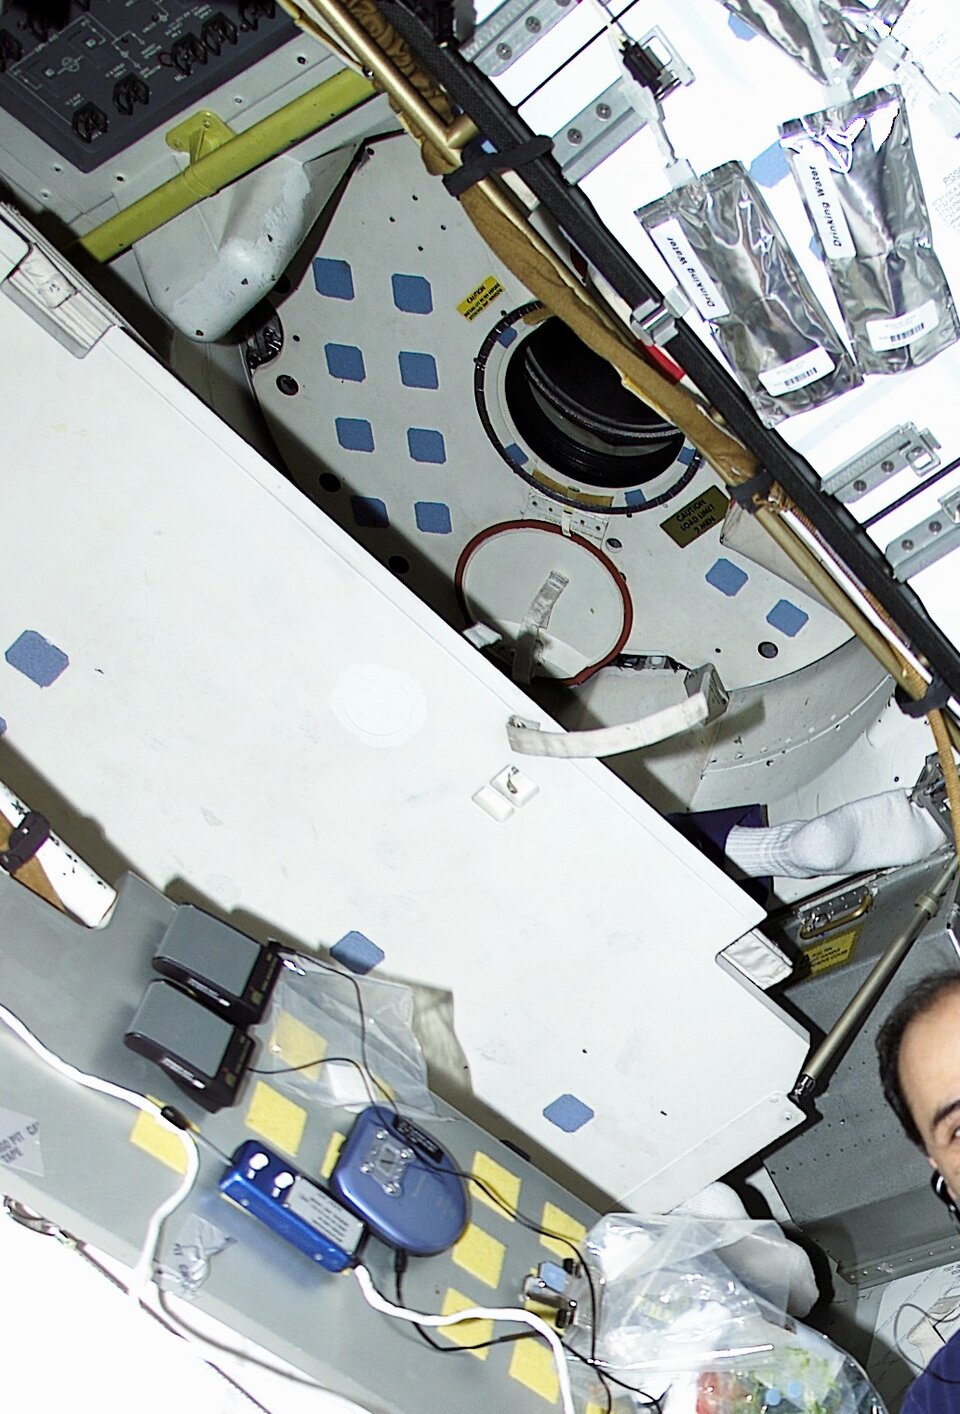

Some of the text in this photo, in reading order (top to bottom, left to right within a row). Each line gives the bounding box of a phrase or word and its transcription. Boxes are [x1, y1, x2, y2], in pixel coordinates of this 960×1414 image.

[809, 165, 842, 248] Drinking Water
[667, 236, 716, 308] Drinking Water
[676, 498, 707, 522] CAUTION
[680, 503, 715, 532] LOAD LIMIT
[699, 515, 716, 530] MEN
